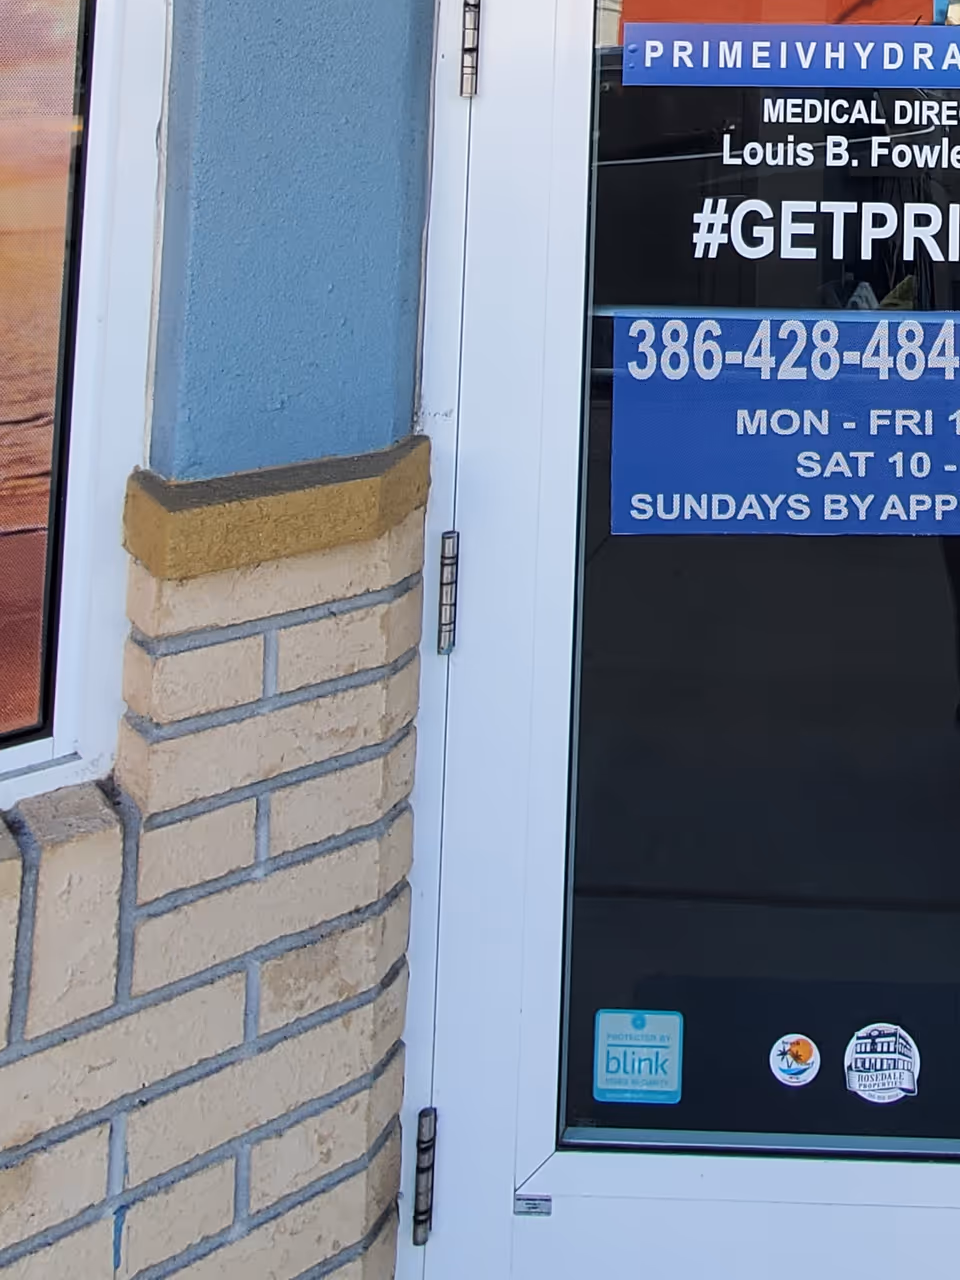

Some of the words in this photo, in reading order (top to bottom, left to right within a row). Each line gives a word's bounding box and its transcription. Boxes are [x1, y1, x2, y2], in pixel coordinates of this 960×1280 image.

[763, 98, 885, 125] MEDICAL
[722, 134, 814, 168] Louis
[826, 136, 858, 167] B.
[736, 409, 831, 436] MON
[869, 409, 935, 436] FRI
[796, 451, 875, 478] SAT
[889, 451, 932, 478] 10
[629, 494, 811, 521] SUNDAYS
[823, 494, 878, 521] BY
[606, 1049, 670, 1076] blink
[857, 1071, 905, 1083] ROSEDALE
